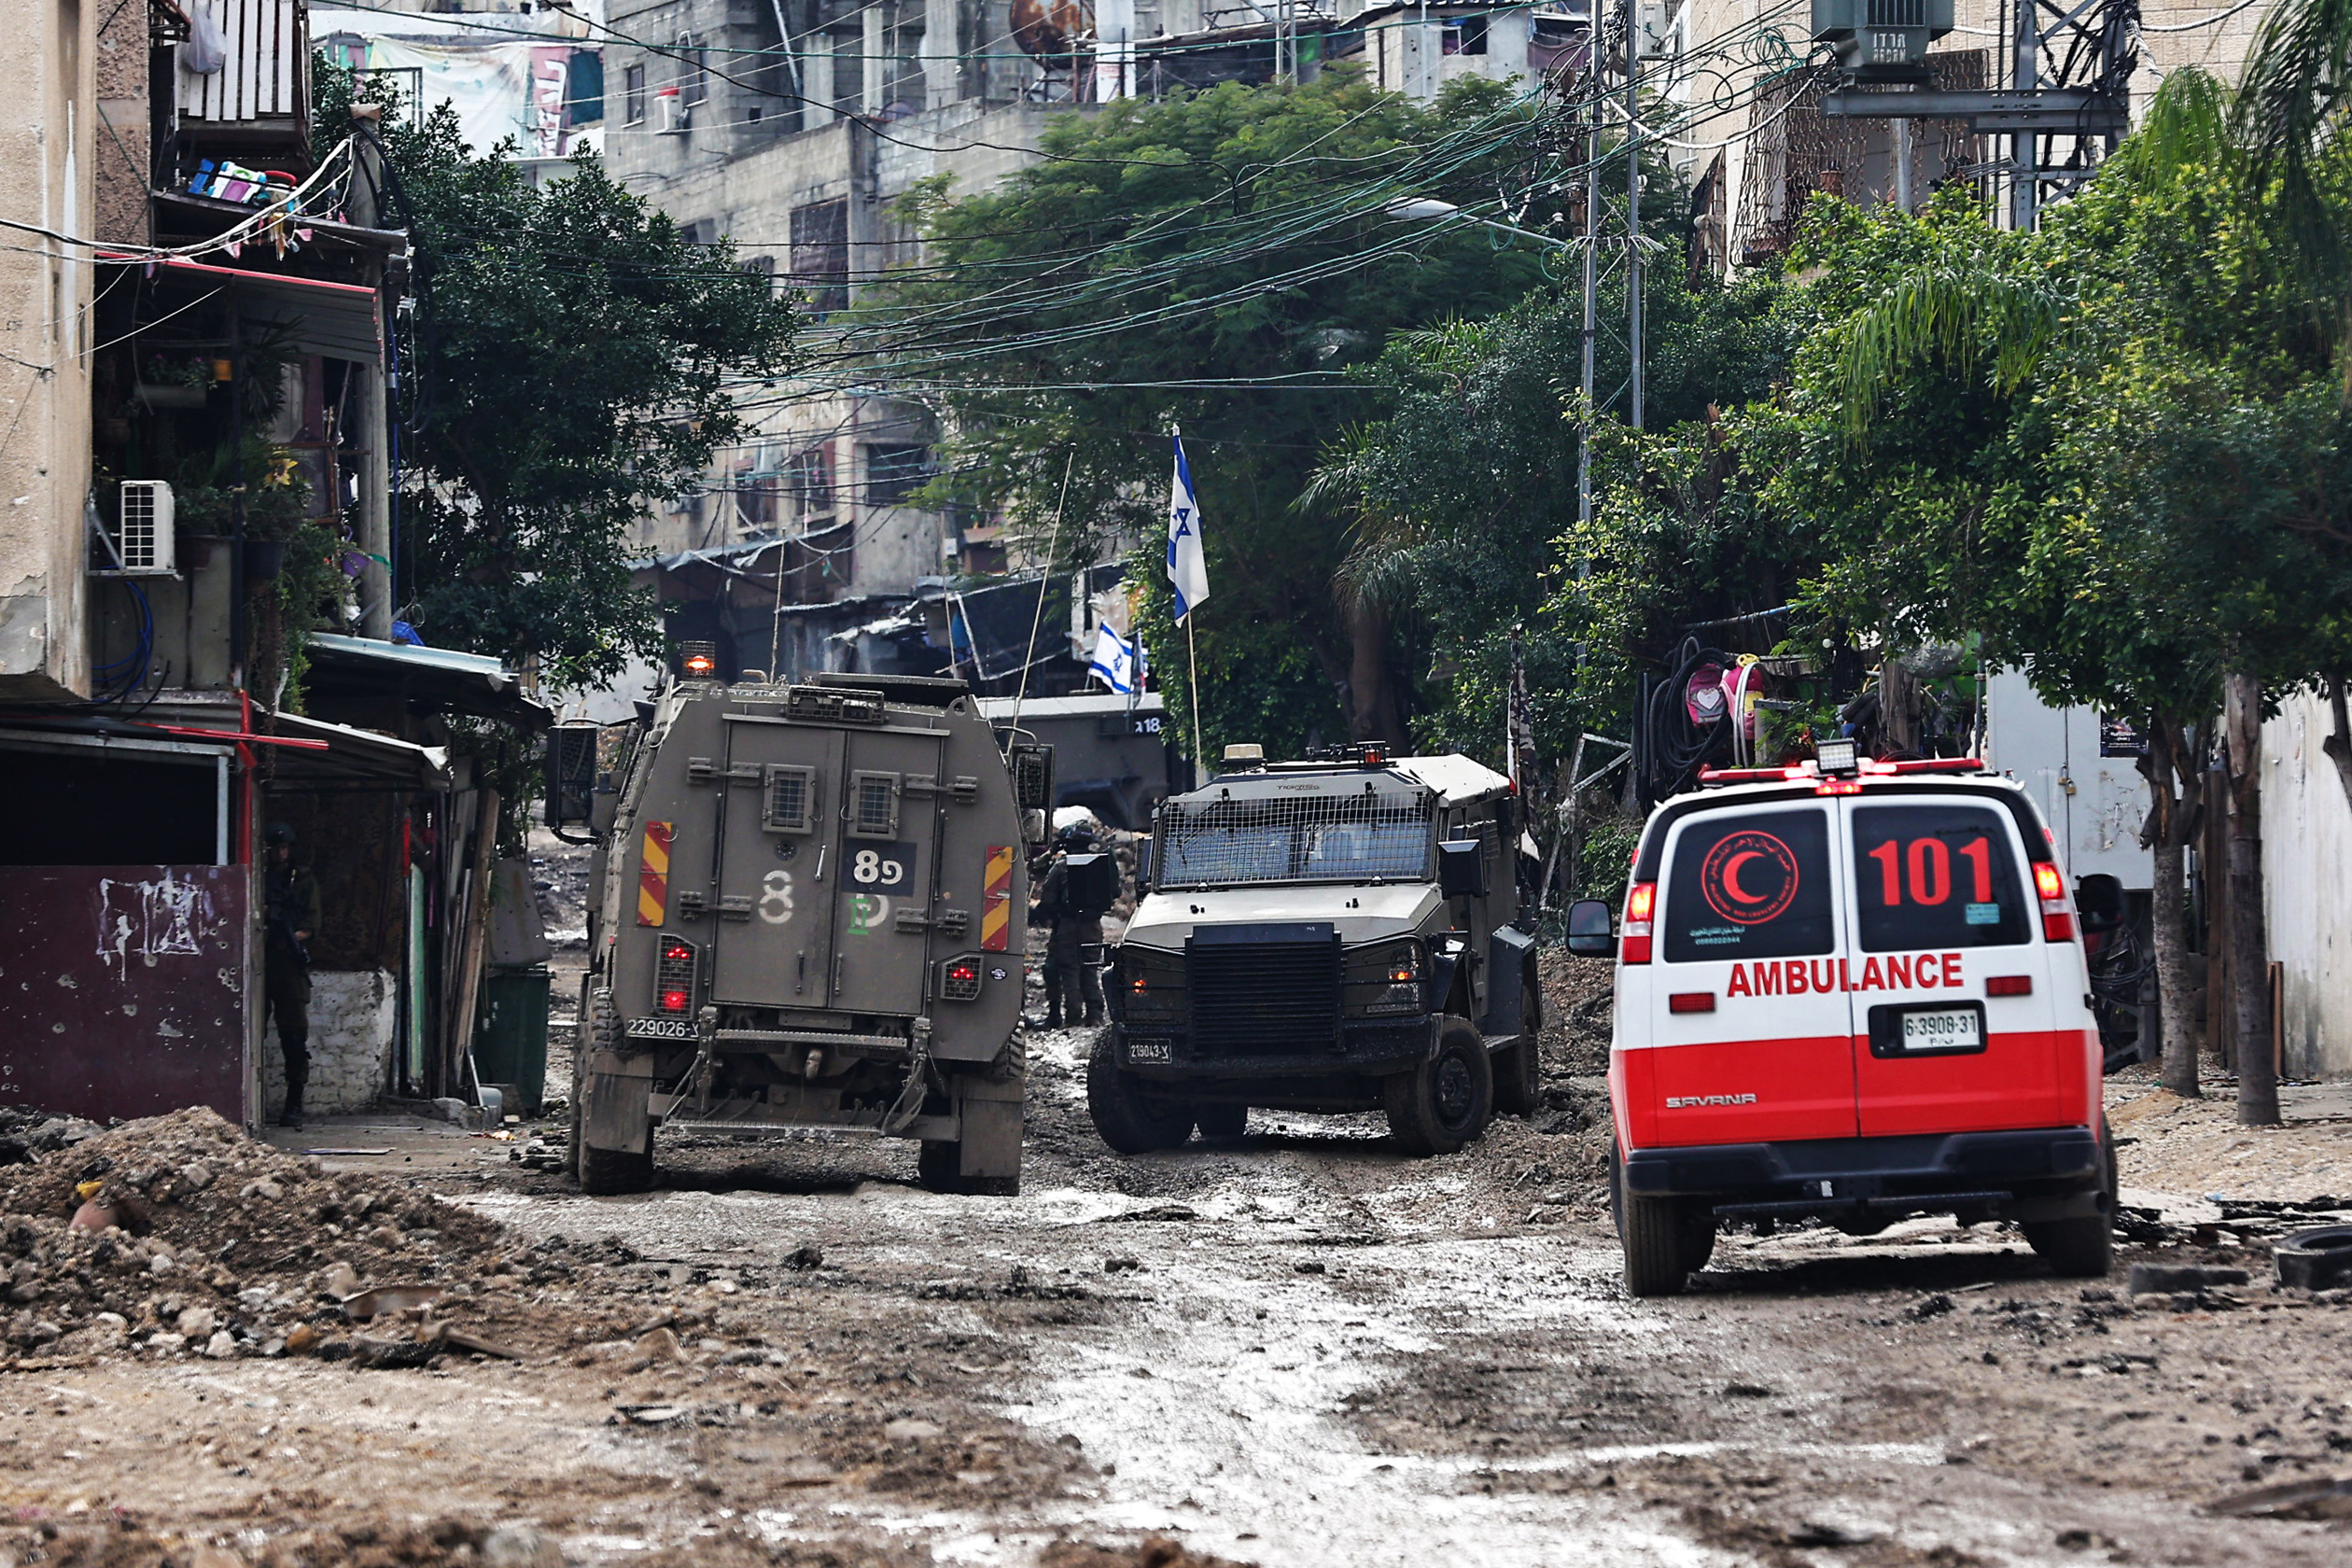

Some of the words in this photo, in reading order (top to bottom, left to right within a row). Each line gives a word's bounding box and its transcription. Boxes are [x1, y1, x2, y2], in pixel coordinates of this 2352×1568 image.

[1869, 837, 1992, 906] 101
[758, 870, 794, 925] 8
[1727, 953, 1965, 998] AMBULANCE
[1666, 1093, 1757, 1109] SAVANA
